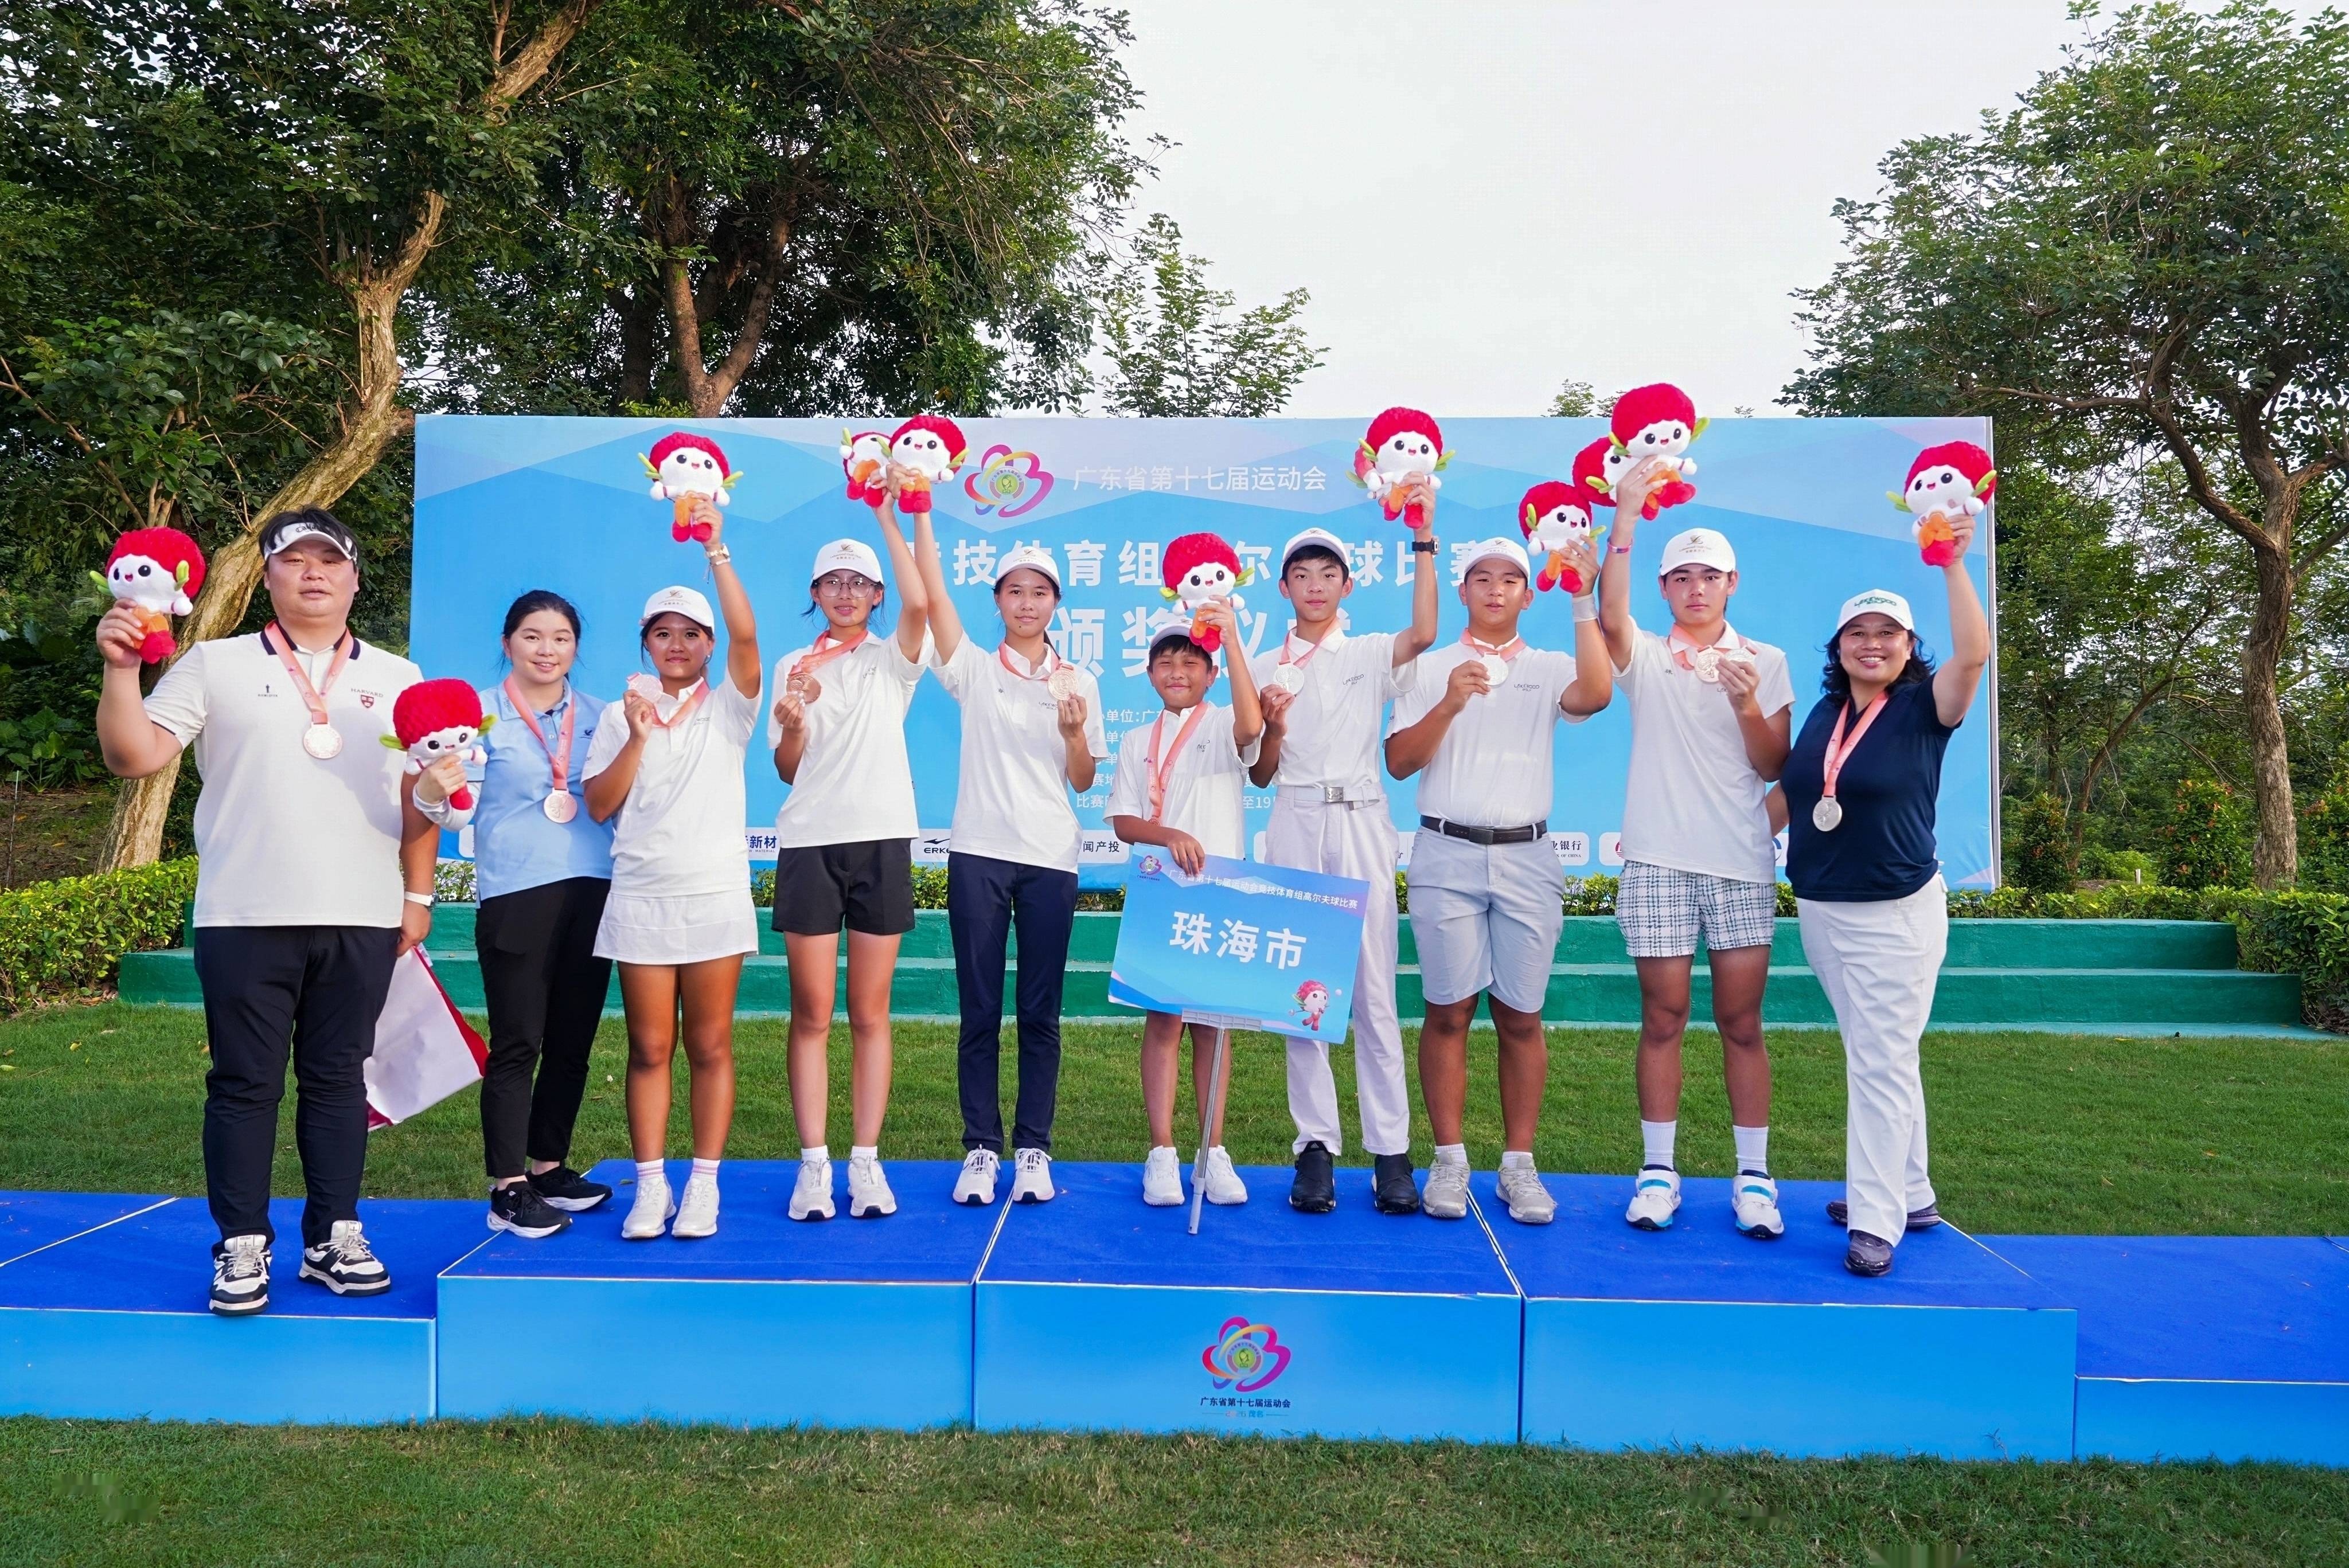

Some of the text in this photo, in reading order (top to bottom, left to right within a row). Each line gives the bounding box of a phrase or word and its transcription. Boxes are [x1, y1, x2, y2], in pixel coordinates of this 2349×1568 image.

[1073, 466, 1326, 491] 广东省第十七届运动会
[351, 688, 384, 698] HARVARD
[1243, 796, 1276, 809] 至19
[746, 835, 777, 848] 新材
[1083, 841, 1120, 853] 闻产投
[1169, 910, 1306, 970] 珠海市
[1200, 1397, 1291, 1408] 广东省第十七届运动会
